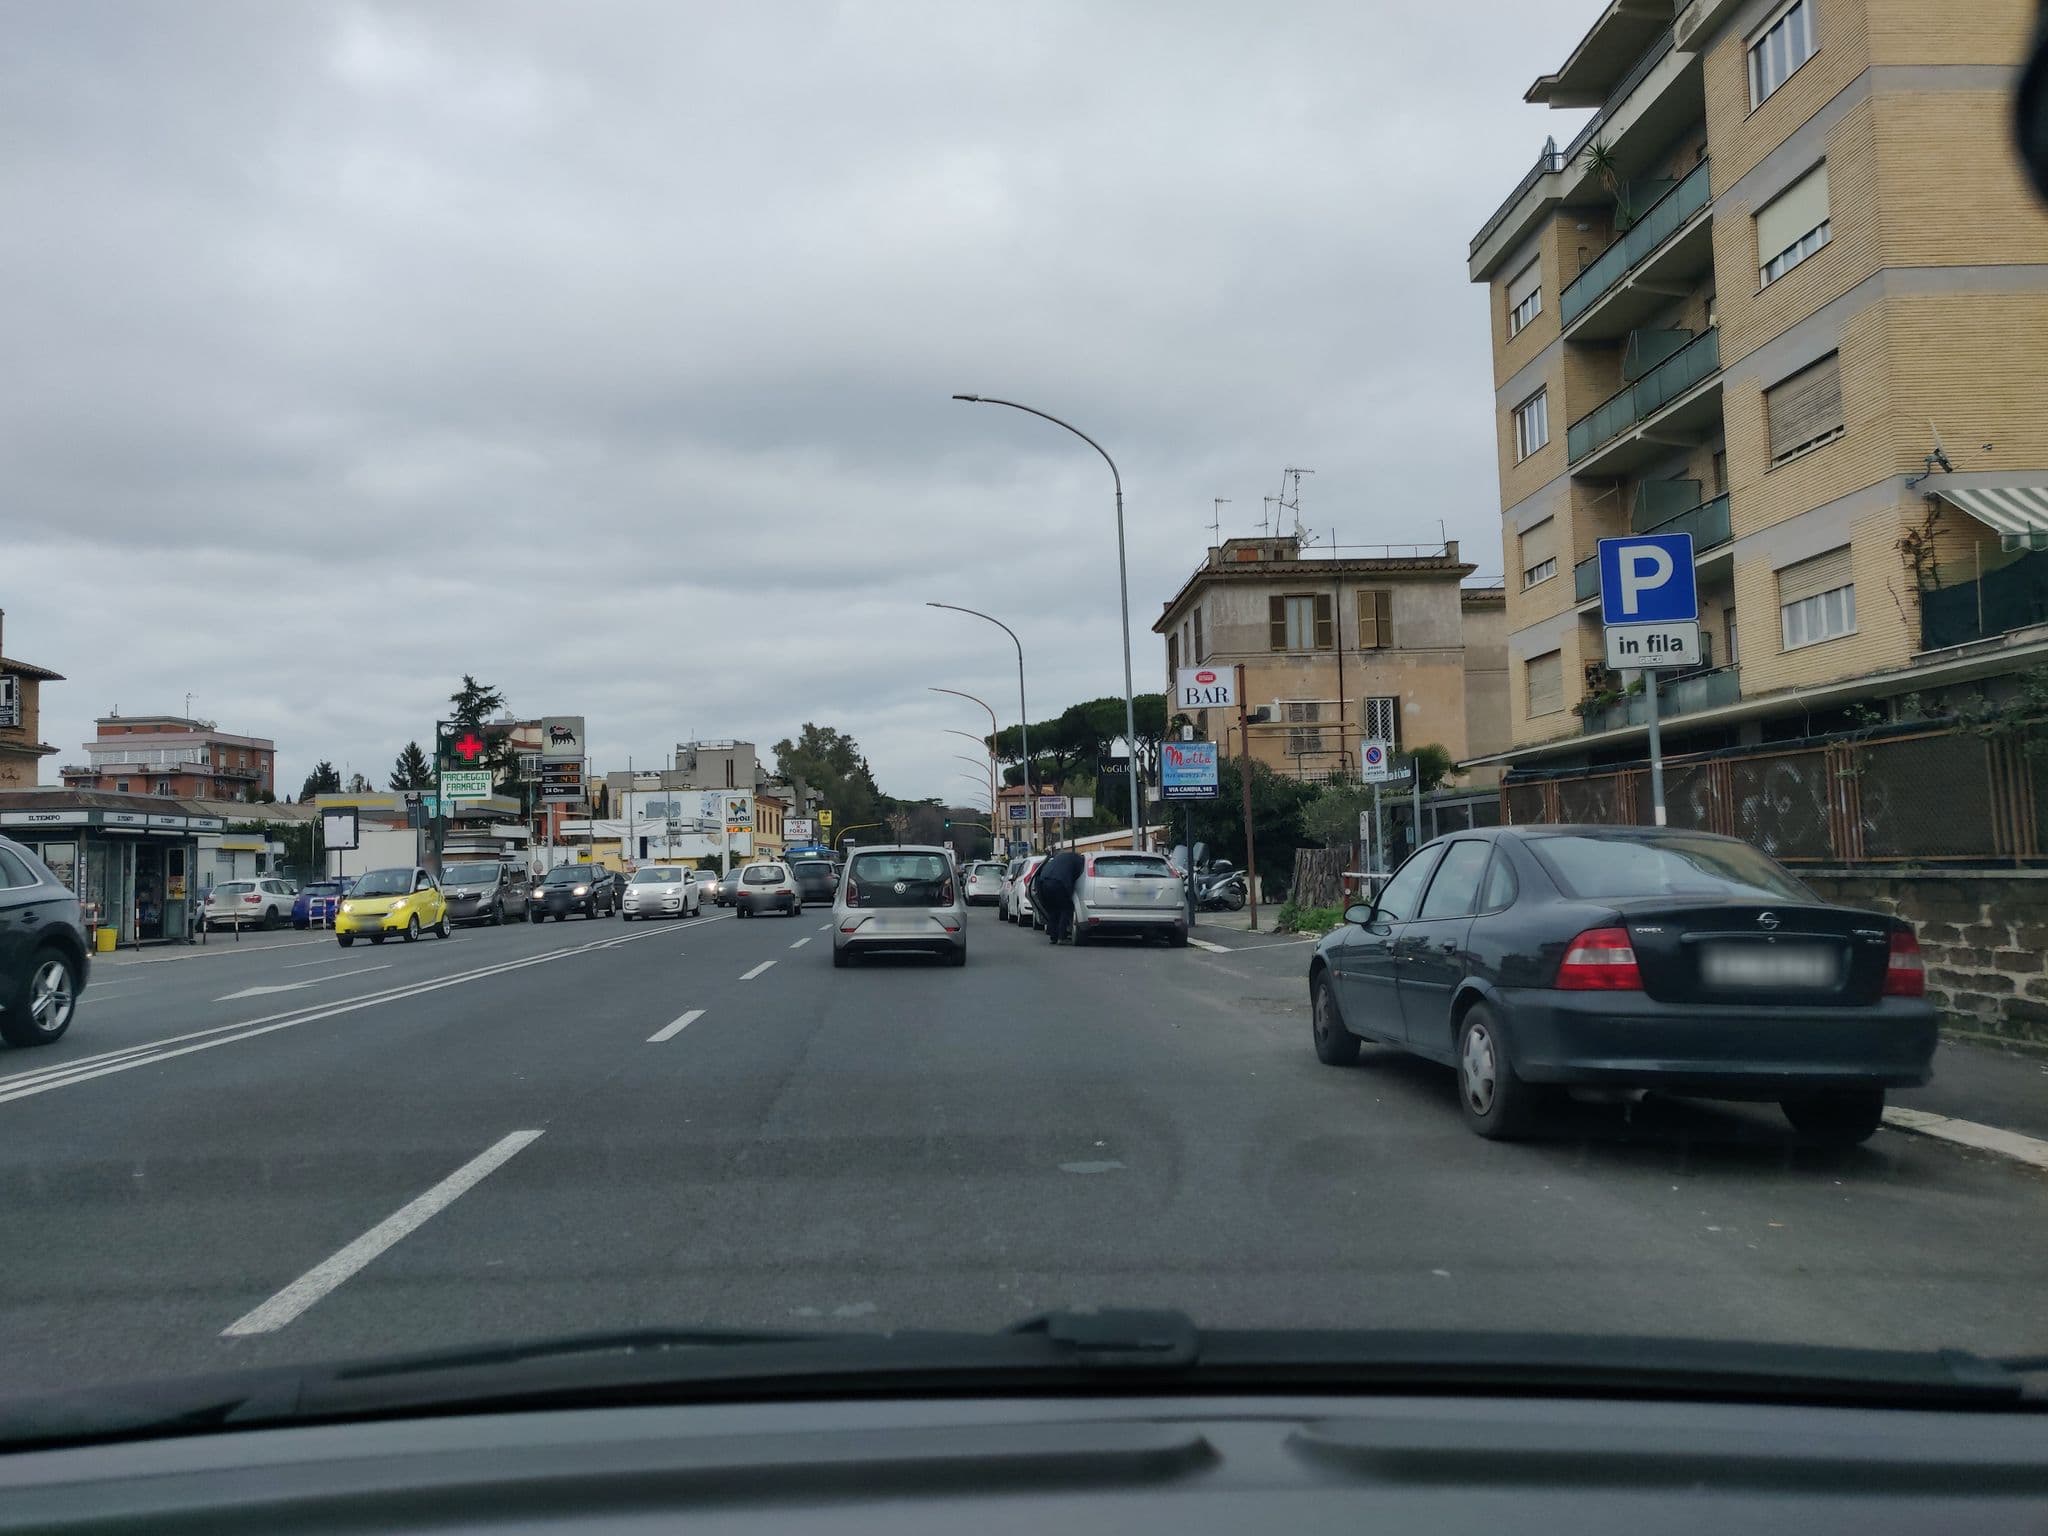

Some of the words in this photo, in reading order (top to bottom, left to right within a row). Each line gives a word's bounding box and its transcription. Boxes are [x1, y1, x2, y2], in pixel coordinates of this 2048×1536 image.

[1618, 545, 1674, 615] P
[1619, 636, 1639, 654] in
[1647, 634, 1683, 653] fila
[1185, 687, 1230, 704] BAR
[442, 772, 491, 781] PARCHEGGIO
[446, 783, 487, 791] FARMACIA
